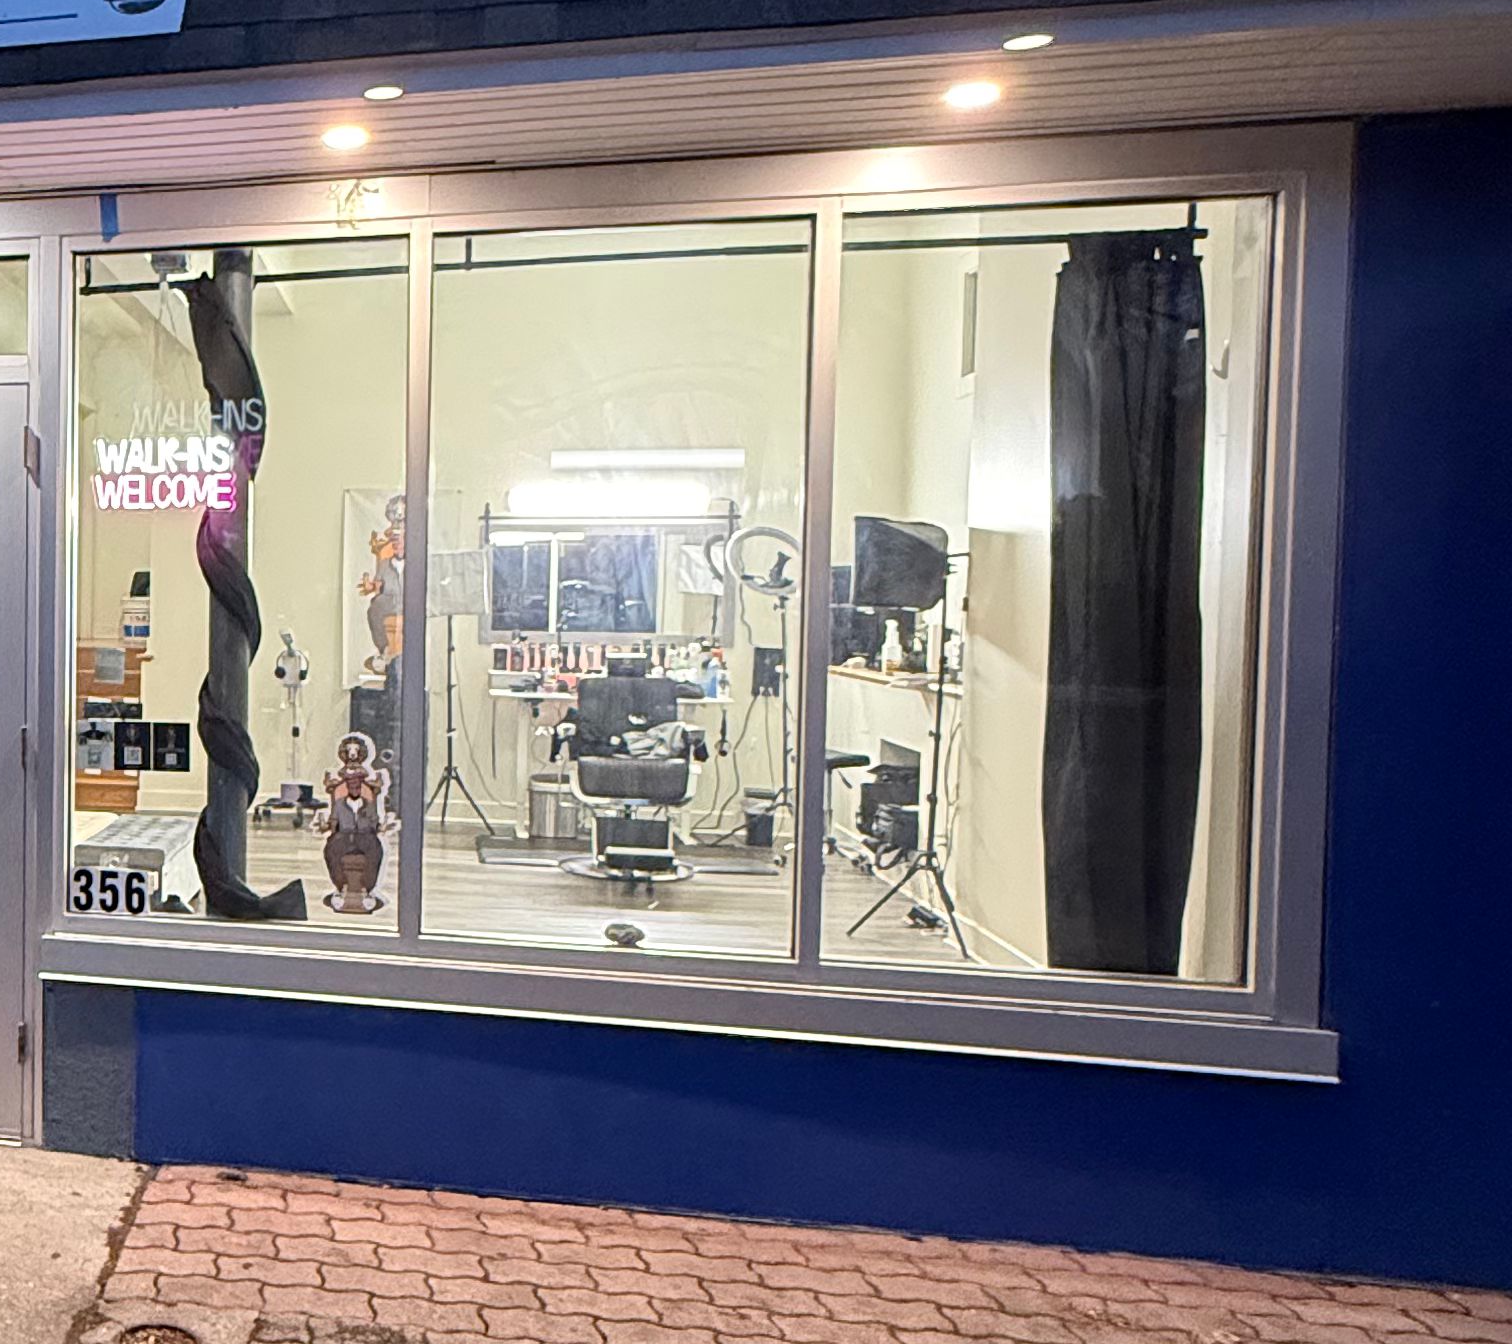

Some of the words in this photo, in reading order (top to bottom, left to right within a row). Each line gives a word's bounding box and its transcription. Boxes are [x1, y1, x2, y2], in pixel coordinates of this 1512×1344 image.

[94, 435, 233, 475] WALK-INS
[93, 472, 235, 510] WELCOME
[73, 869, 145, 915] 356
